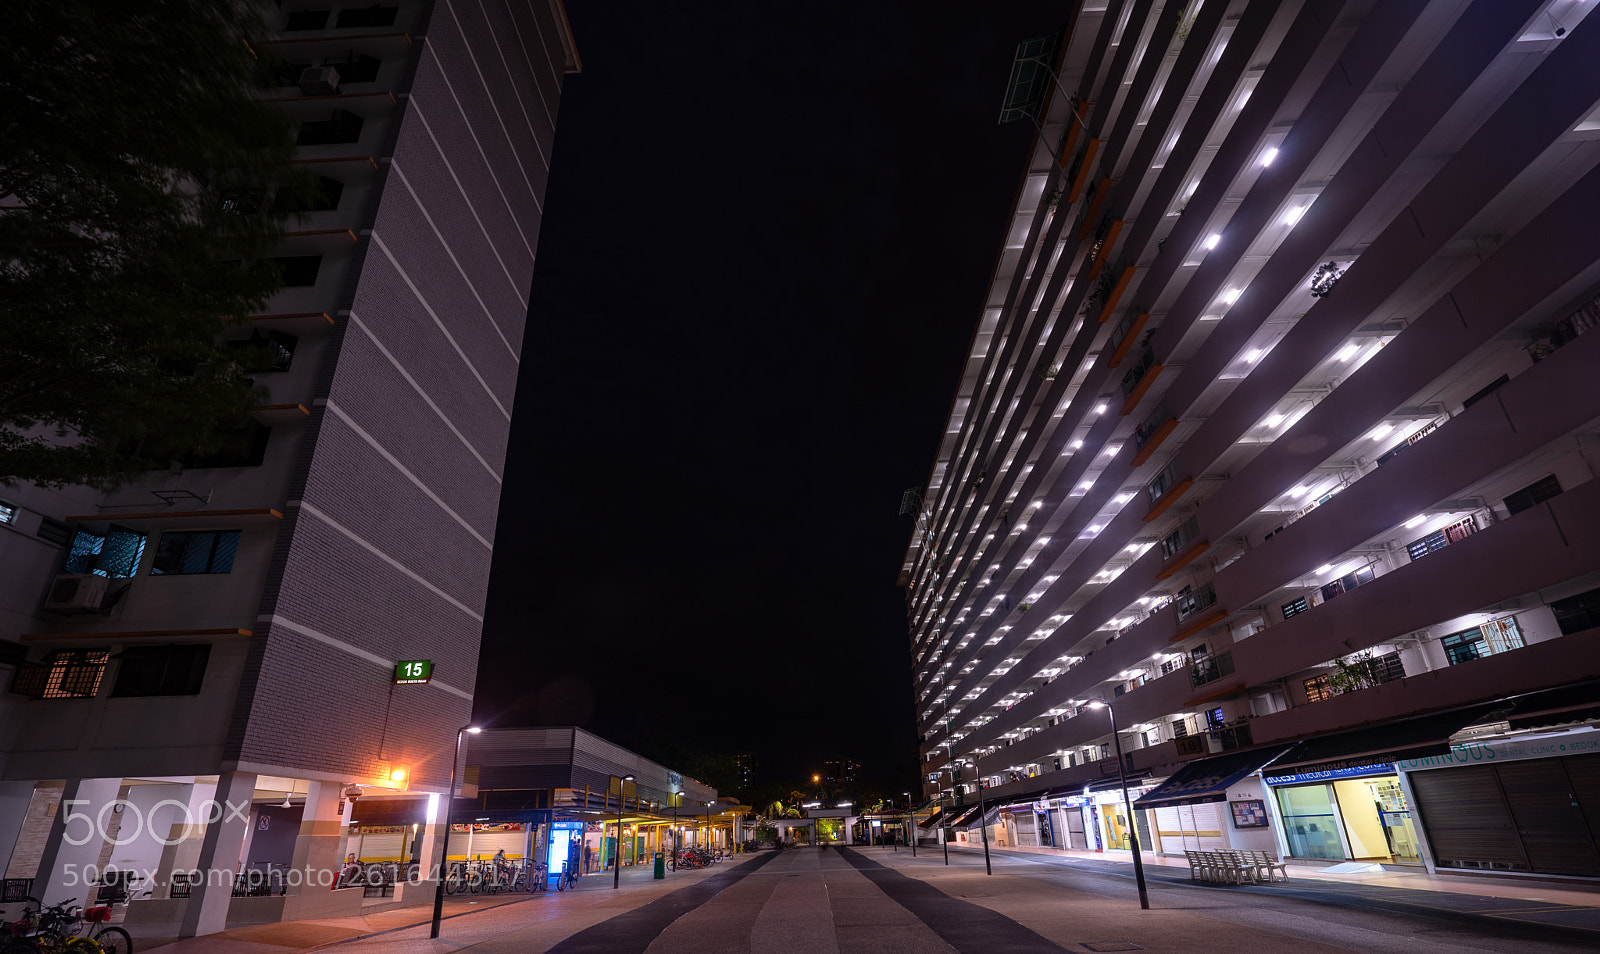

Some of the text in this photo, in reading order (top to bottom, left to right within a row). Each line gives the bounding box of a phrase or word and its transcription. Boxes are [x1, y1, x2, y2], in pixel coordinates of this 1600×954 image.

[404, 662, 423, 677] 15
[1181, 740, 1196, 751] 18
[1500, 749, 1529, 758] DENTAL
[1531, 744, 1556, 755] CLINIC
[1294, 761, 1347, 774] Luminous
[1348, 757, 1373, 767] dental
[1374, 754, 1396, 764] clinic
